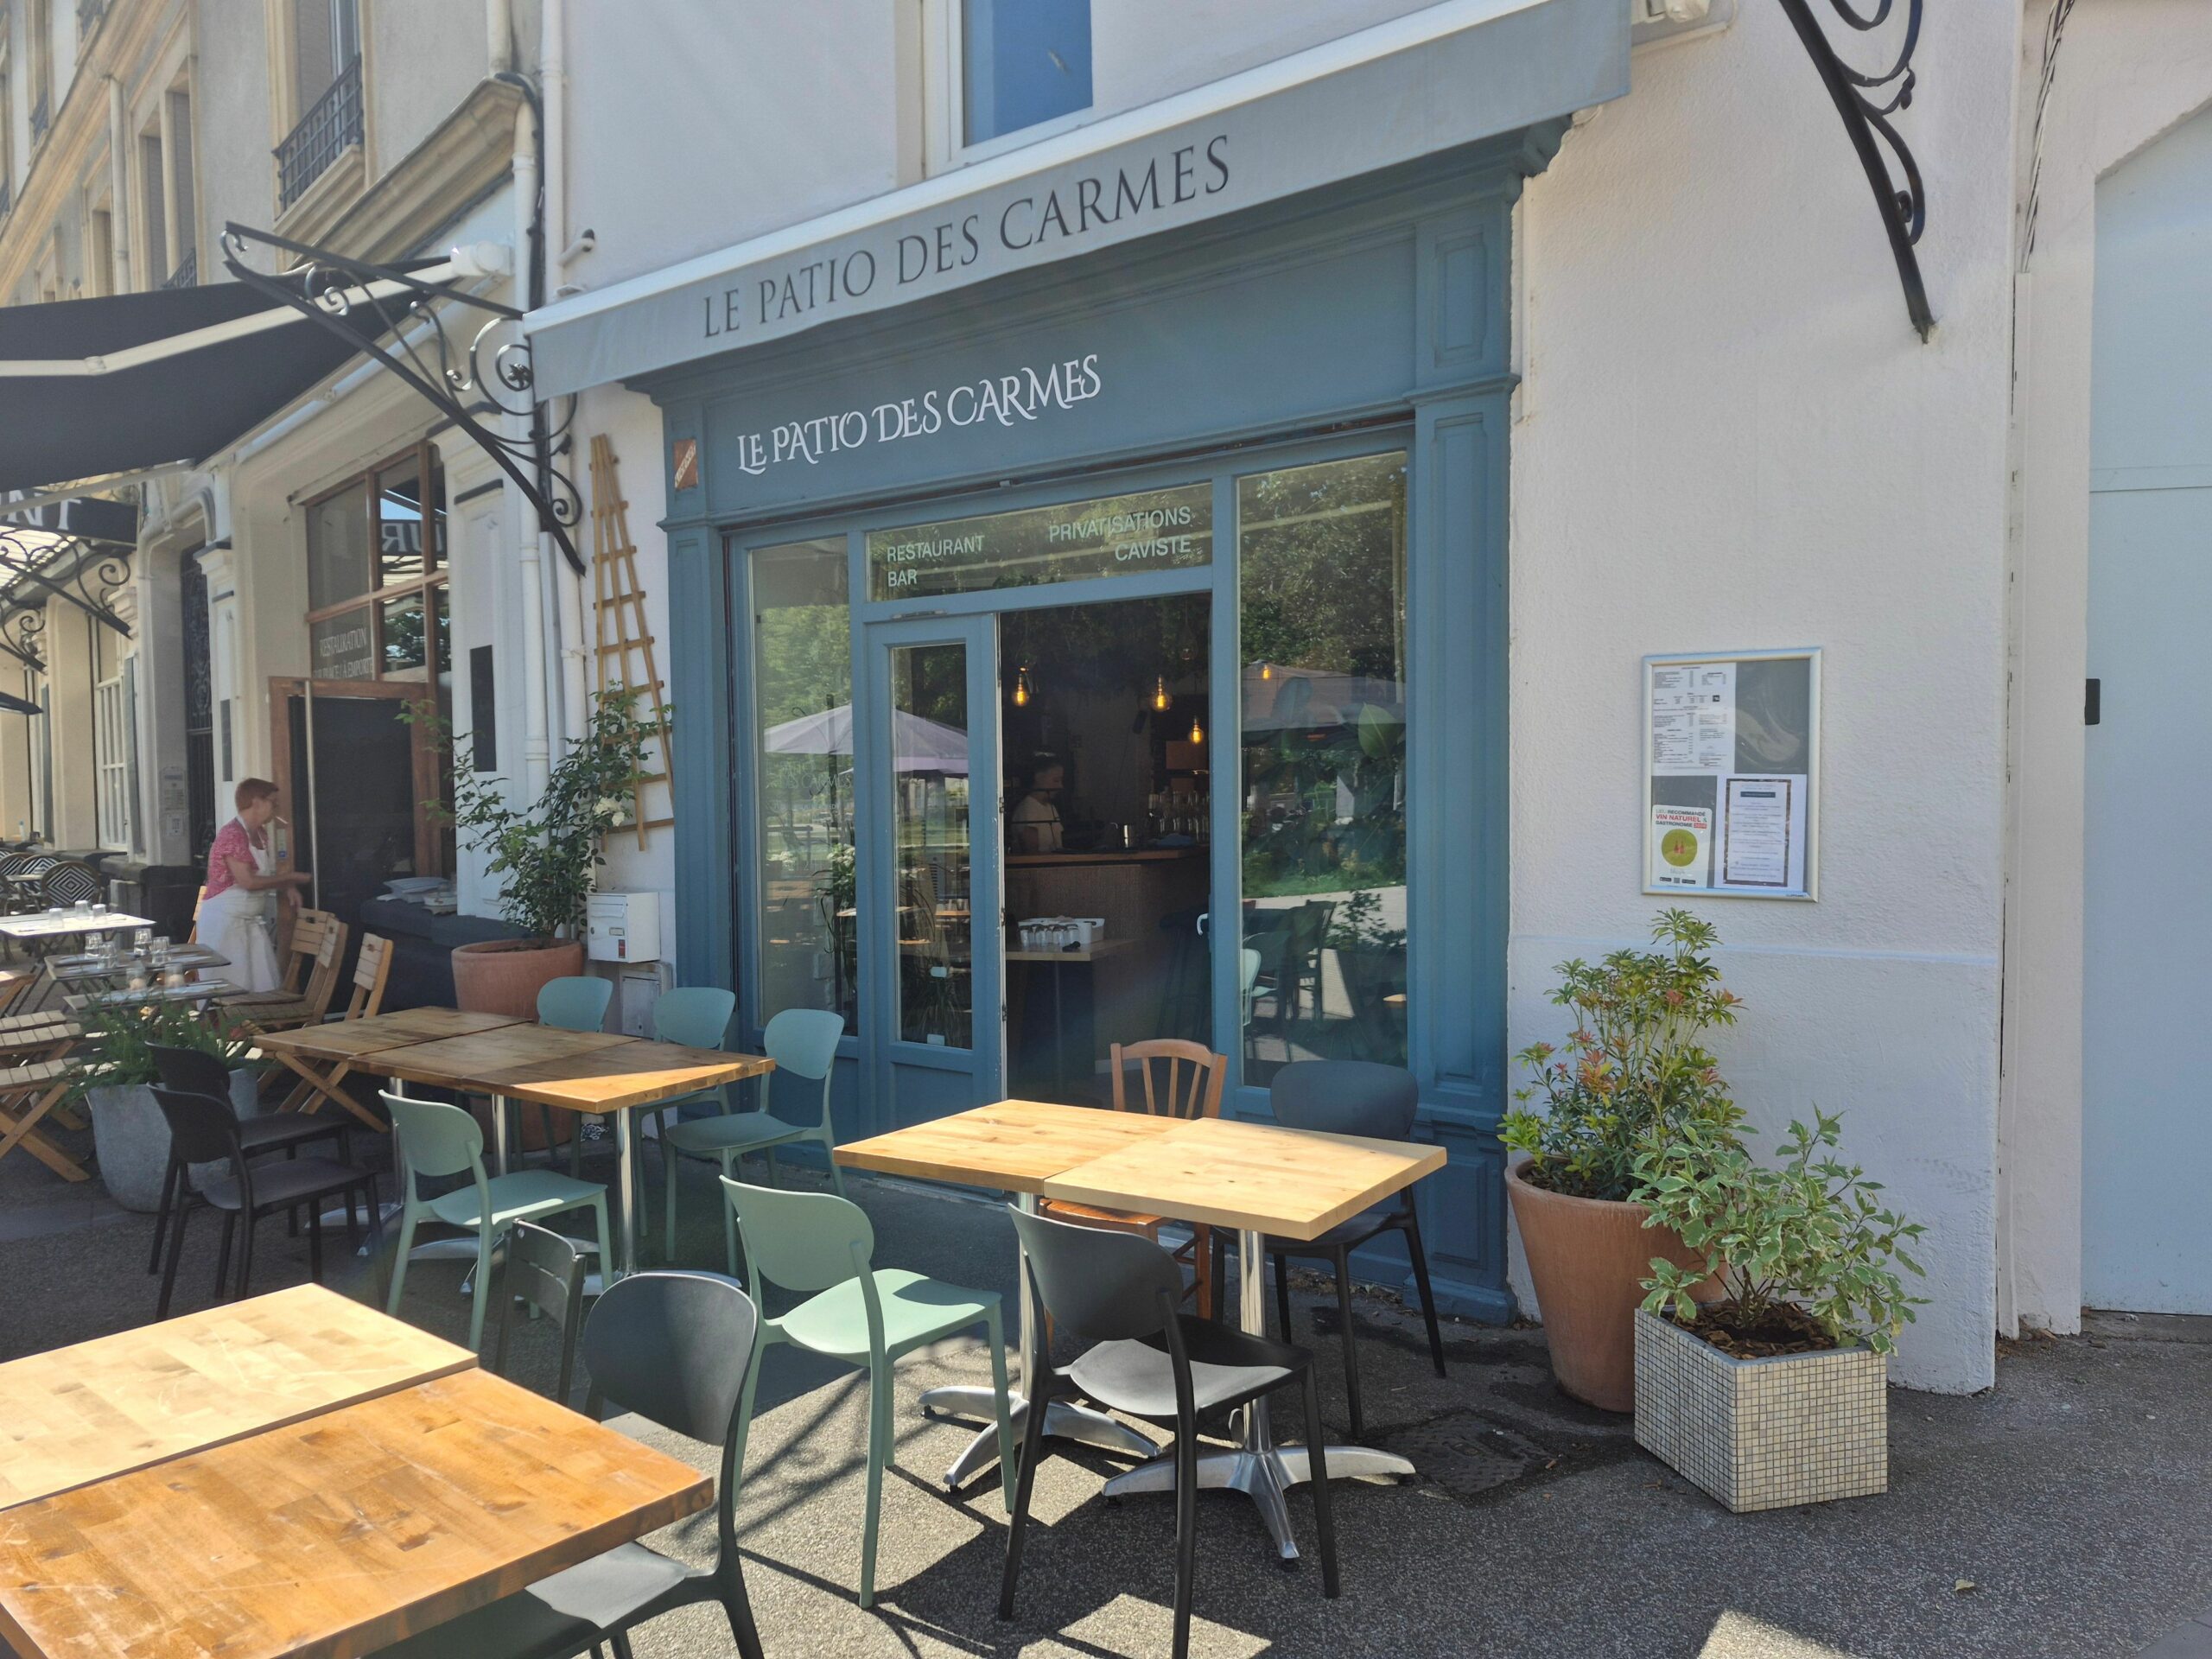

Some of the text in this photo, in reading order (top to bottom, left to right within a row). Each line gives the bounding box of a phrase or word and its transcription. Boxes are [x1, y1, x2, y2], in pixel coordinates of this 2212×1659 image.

[703, 134, 1229, 338] LE PATIO DES CARMES
[737, 434, 767, 475] LE
[772, 410, 868, 465] PATIO
[871, 391, 942, 442] DES
[947, 354, 1101, 427] CARMES
[1049, 506, 1191, 543] PRIVATISATIONS
[887, 535, 985, 563] RESTAURANT
[1115, 535, 1192, 562] CAVISTE
[887, 569, 918, 588] BAR
